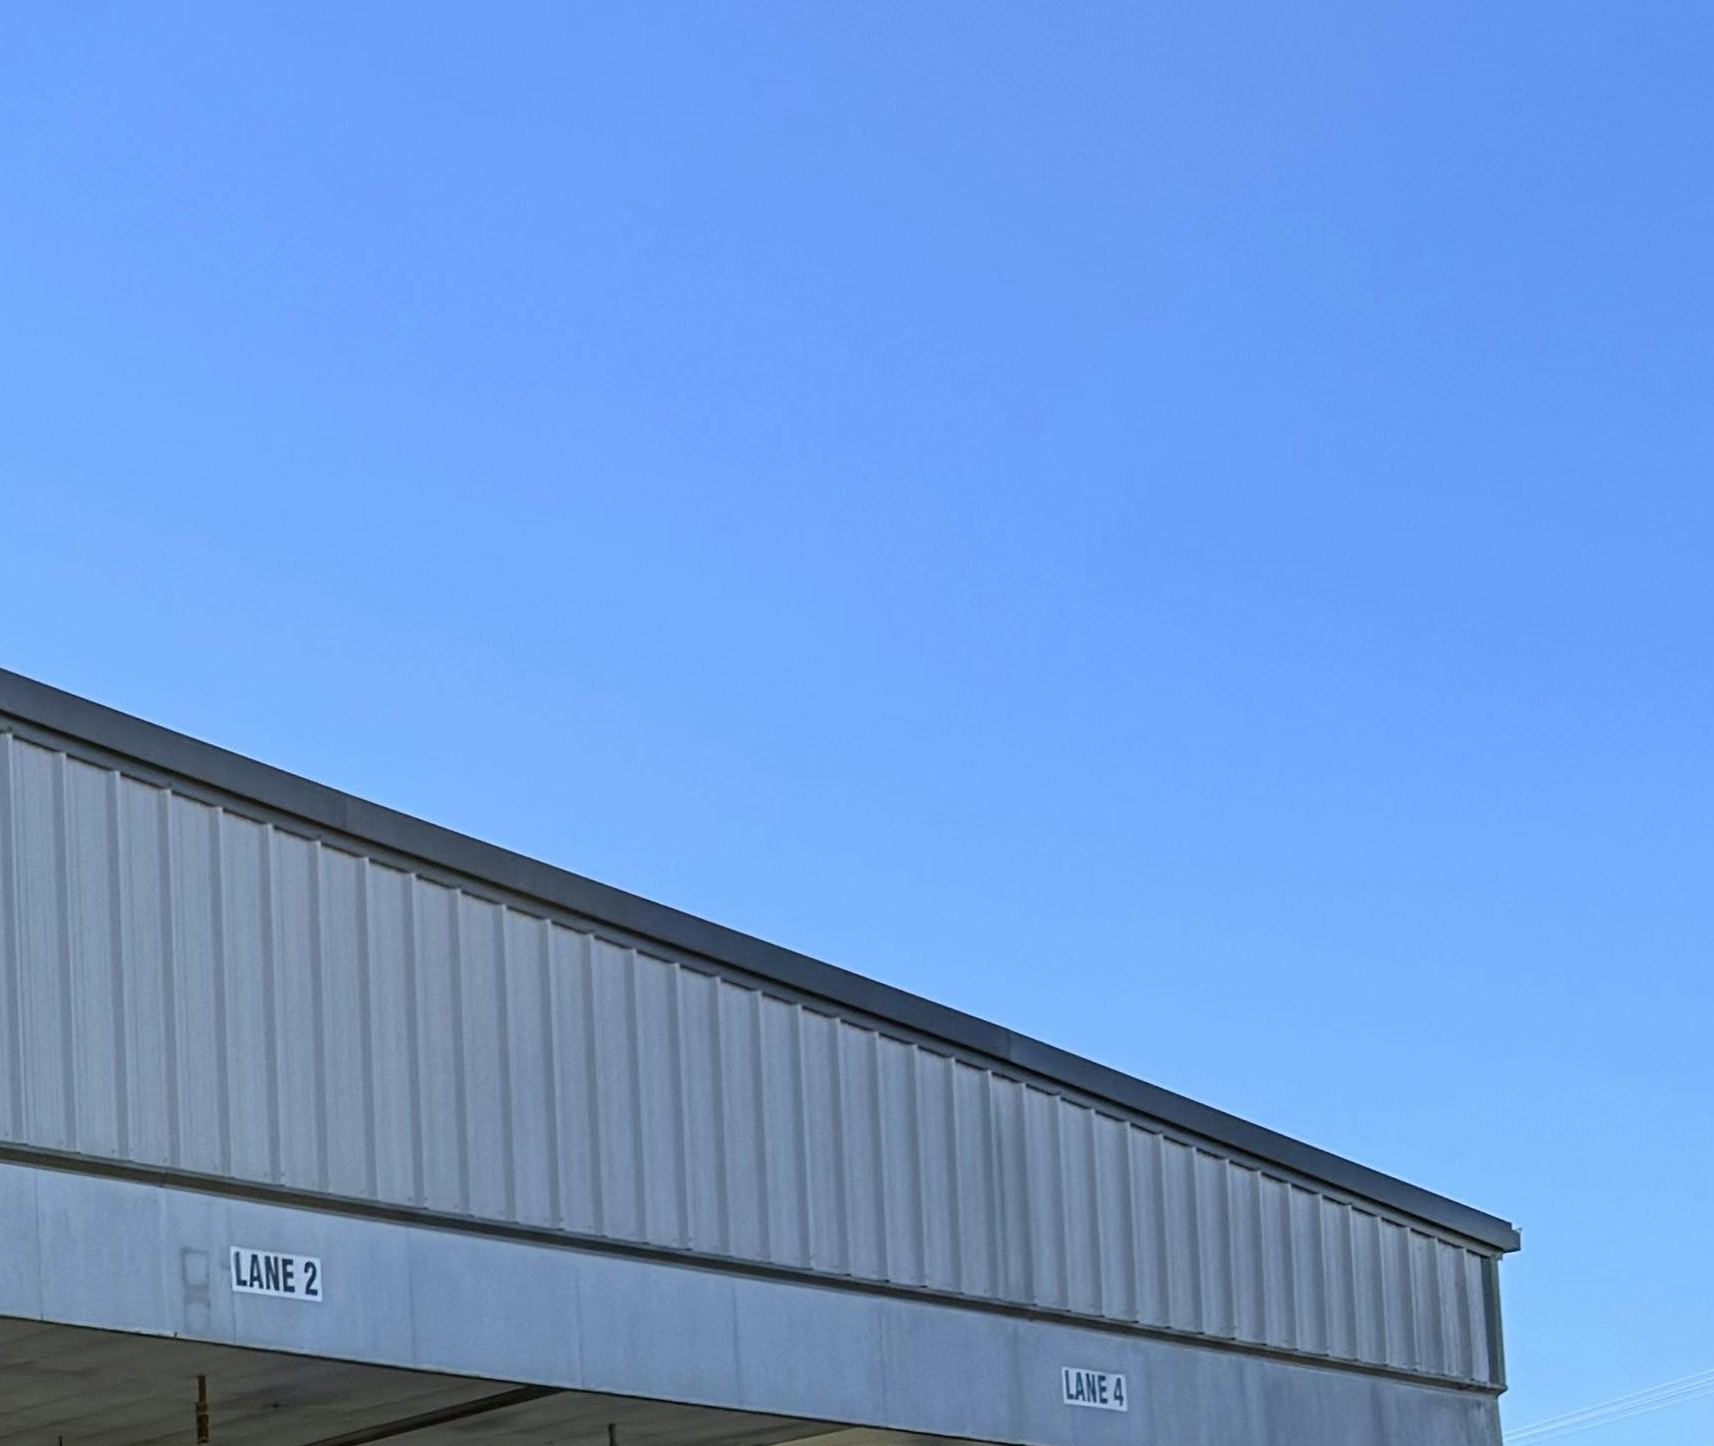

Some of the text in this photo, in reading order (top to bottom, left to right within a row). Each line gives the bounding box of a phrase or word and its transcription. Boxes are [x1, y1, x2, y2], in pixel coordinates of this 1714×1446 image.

[234, 1251, 319, 1296] LANE 2
[1064, 1370, 1124, 1407] LANE 4
